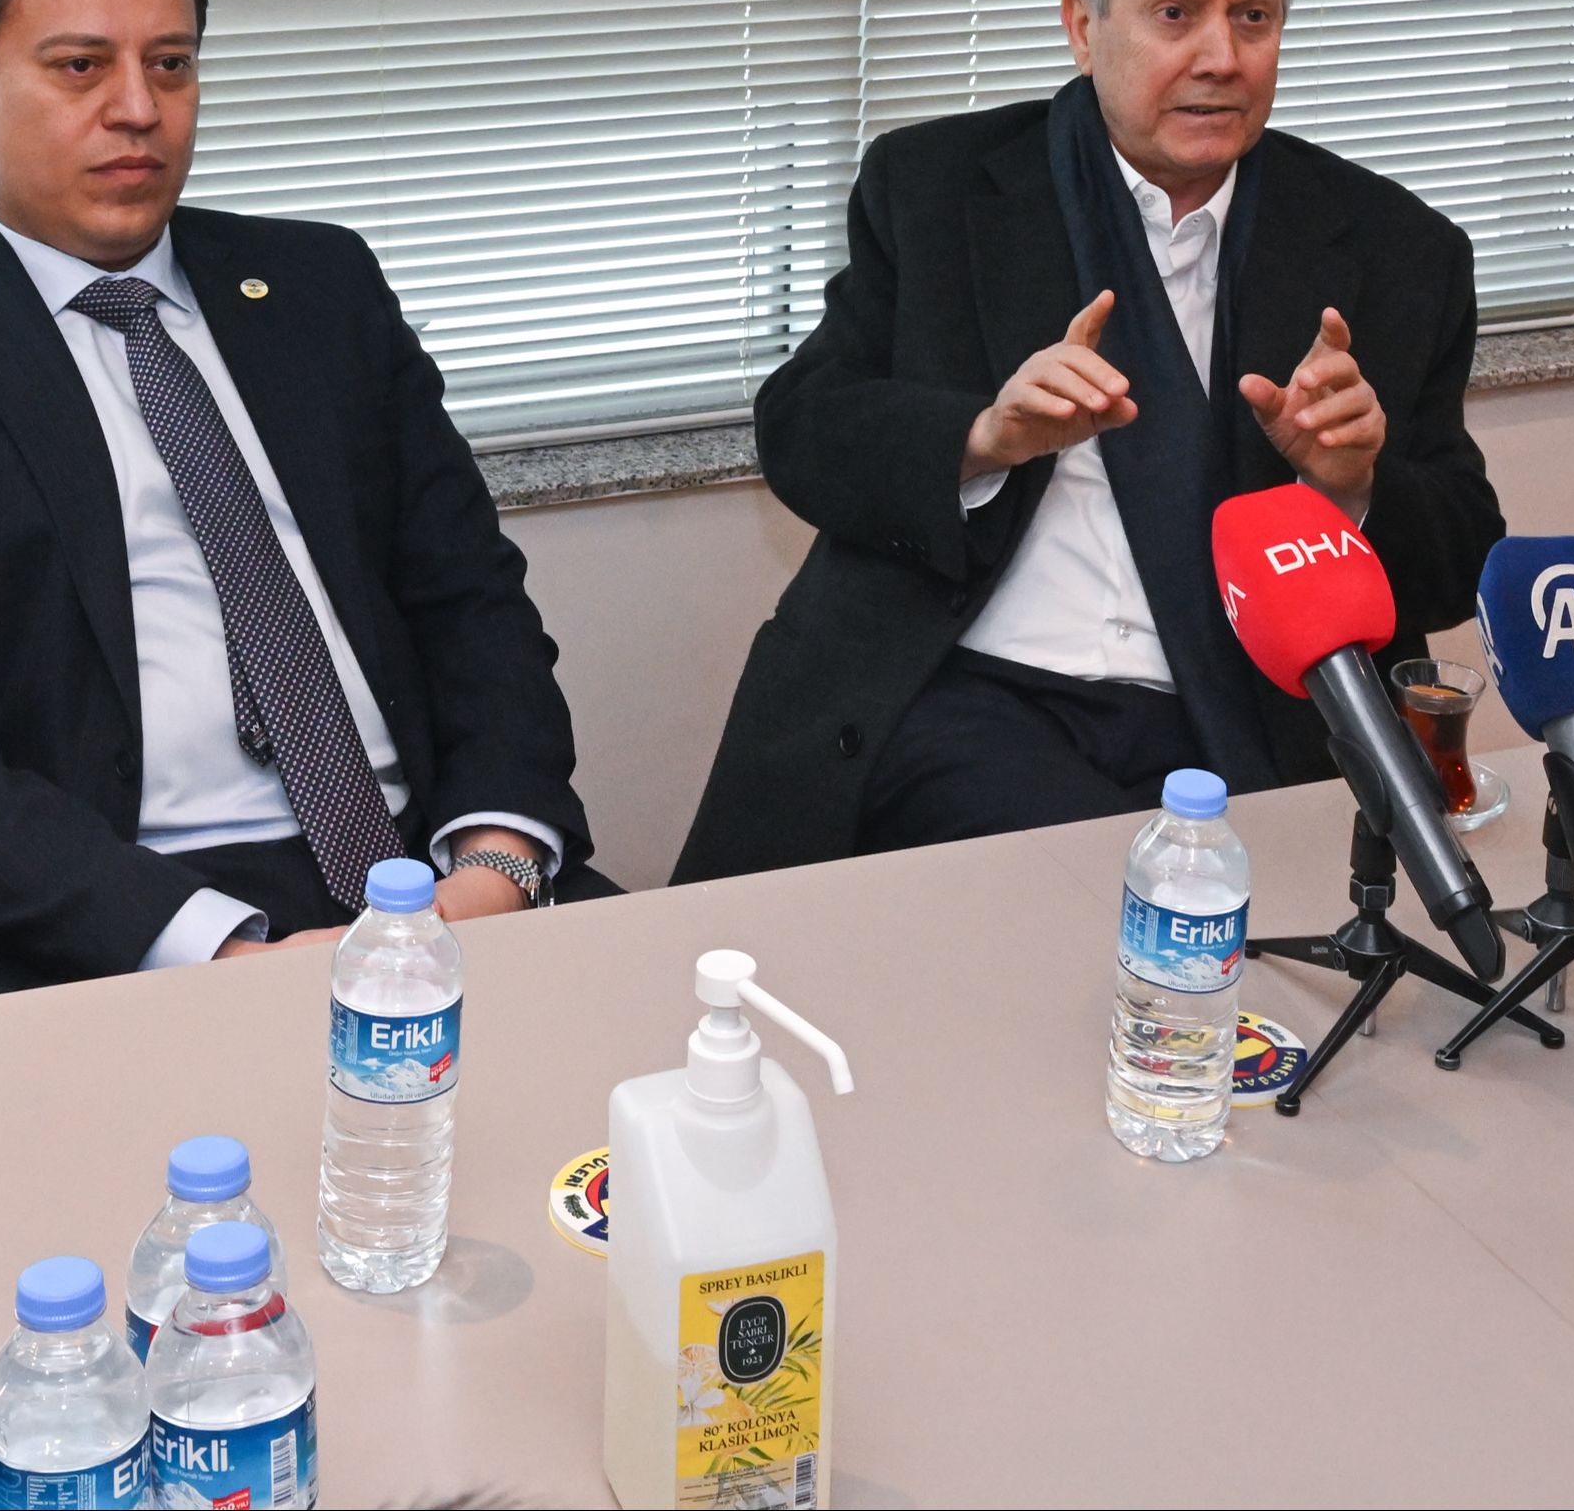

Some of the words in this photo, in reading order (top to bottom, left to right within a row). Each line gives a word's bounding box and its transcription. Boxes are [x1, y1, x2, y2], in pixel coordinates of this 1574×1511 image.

[1264, 530, 1371, 575] DHA
[1170, 916, 1235, 945] Erikli
[370, 1017, 443, 1050] Erikli
[699, 1277, 744, 1294] SPREY
[746, 1263, 808, 1286] BAŞLIKLI
[729, 1334, 775, 1350] TUNCER
[742, 1355, 763, 1367] 1923
[699, 1433, 751, 1453] KLASİK
[754, 1422, 801, 1443] LİMON
[727, 1410, 796, 1434] KOLONYA
[153, 1422, 228, 1473] Erikli
